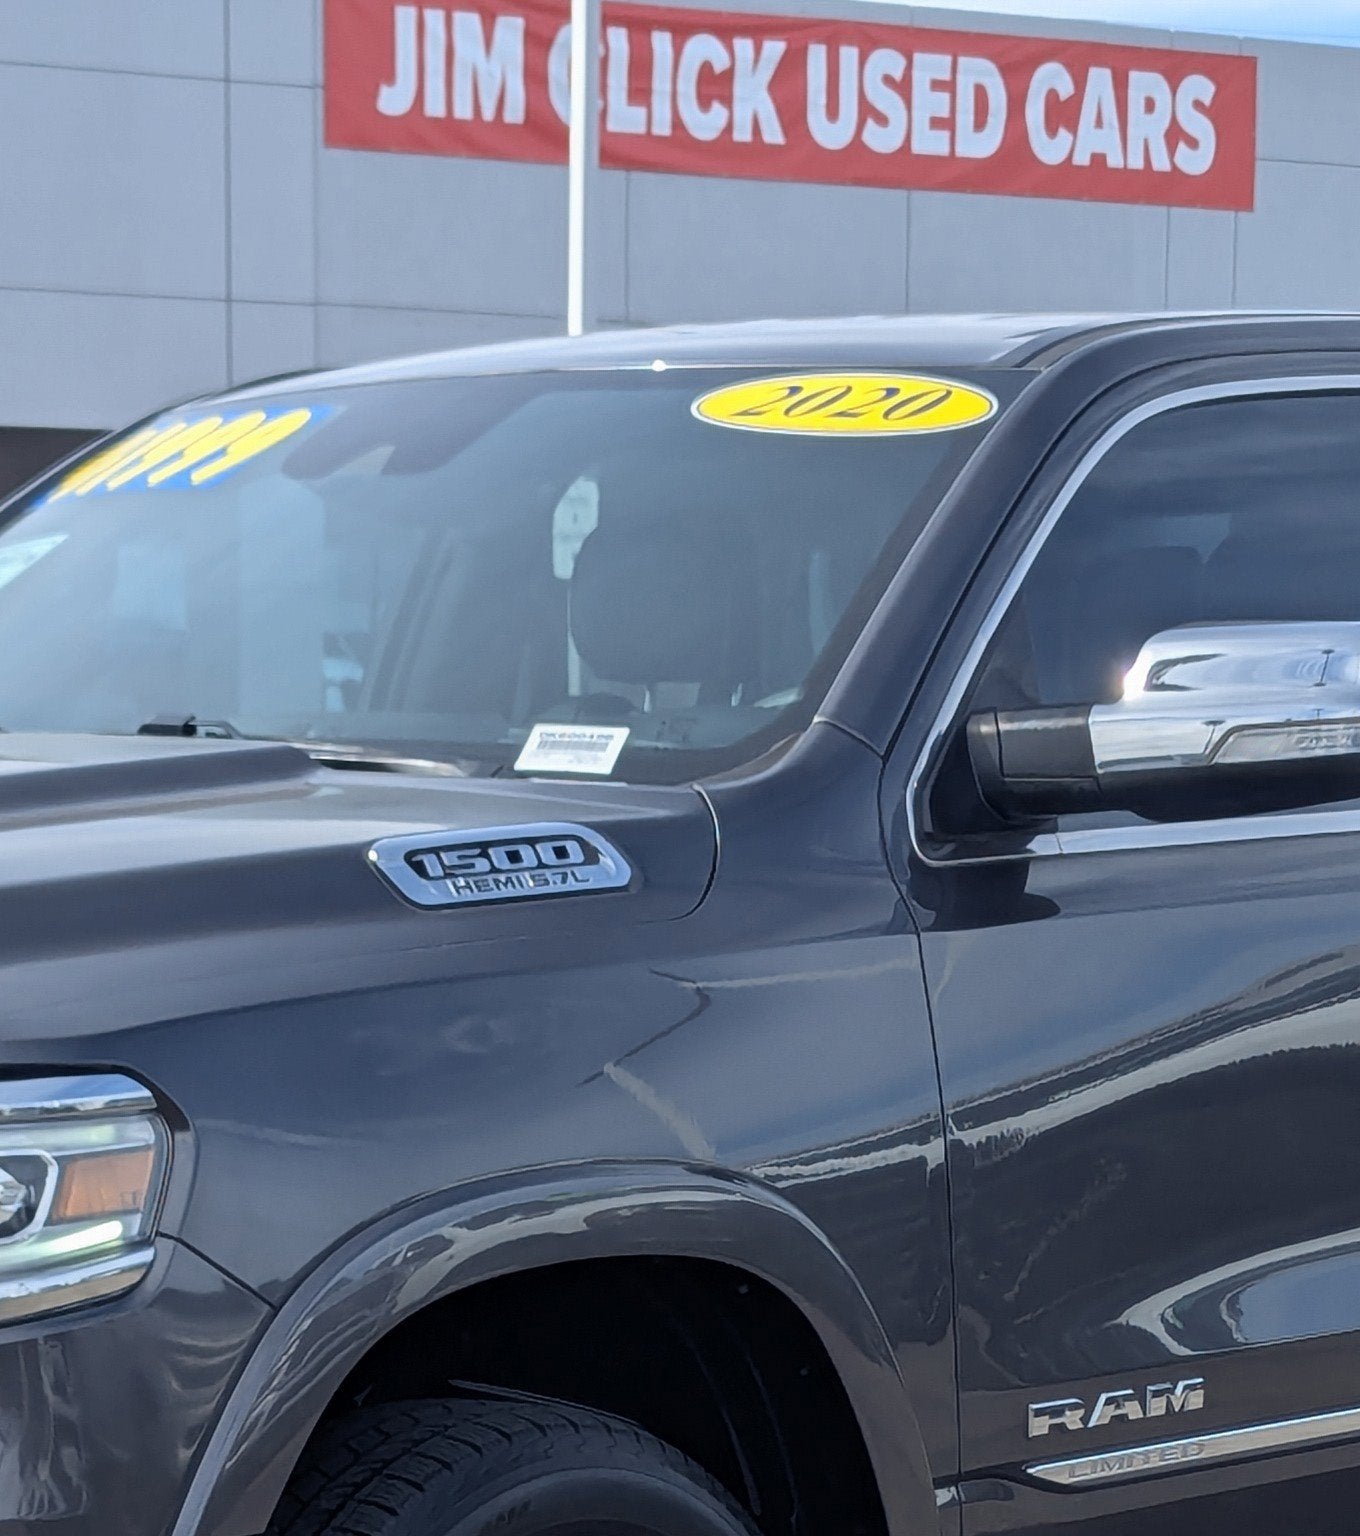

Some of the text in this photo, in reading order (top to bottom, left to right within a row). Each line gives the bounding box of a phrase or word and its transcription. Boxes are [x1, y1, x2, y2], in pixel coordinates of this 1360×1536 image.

[377, 4, 525, 124] JIM
[806, 46, 1006, 160] USED
[1025, 61, 1217, 176] CARS
[728, 384, 954, 422] 2020
[411, 839, 586, 879] 1500
[449, 870, 591, 897] HEMI 5.7L
[1027, 1377, 1205, 1438] RAM
[1067, 1442, 1207, 1480] LIMITED
